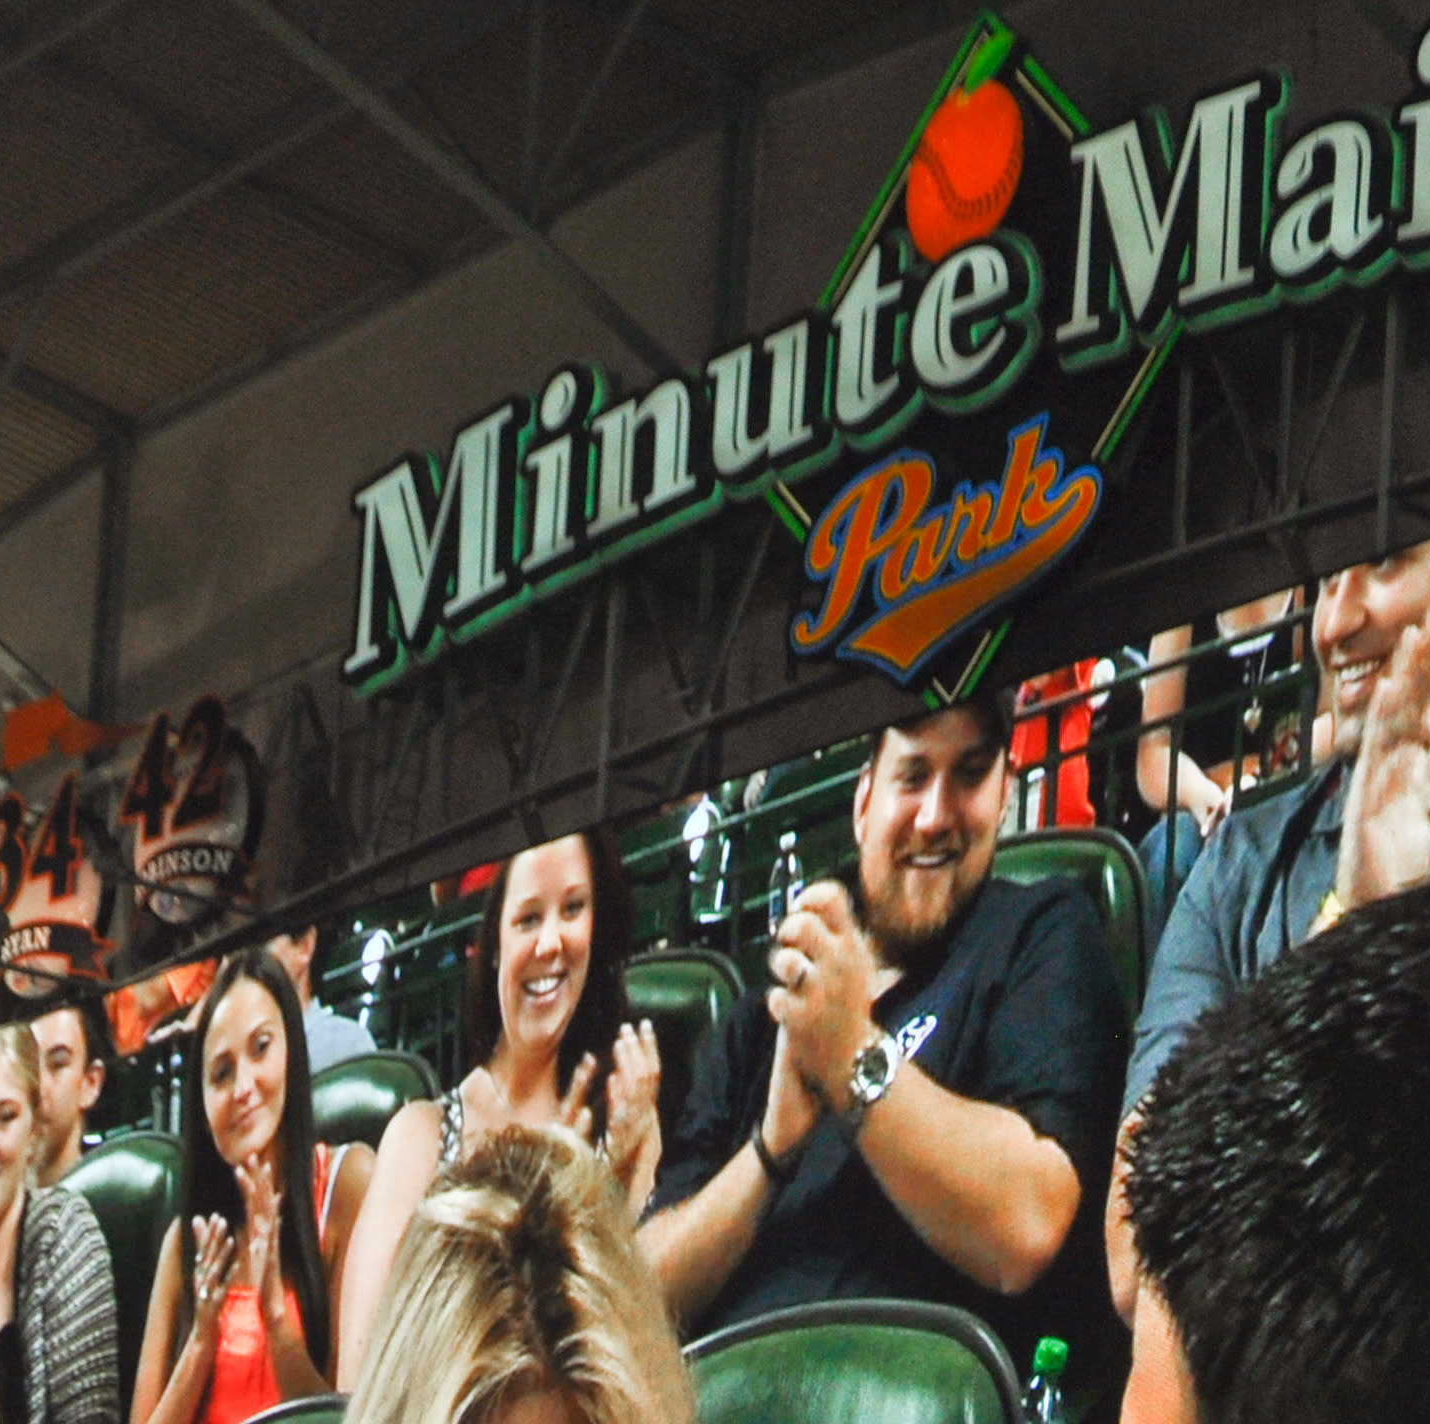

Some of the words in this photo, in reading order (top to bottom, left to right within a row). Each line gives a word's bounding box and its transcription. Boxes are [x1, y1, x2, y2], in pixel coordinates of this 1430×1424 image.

[345, 243, 1013, 675] Minute
[792, 411, 1102, 662] Park
[120, 692, 227, 846] 42
[0, 924, 52, 963] RYAN
